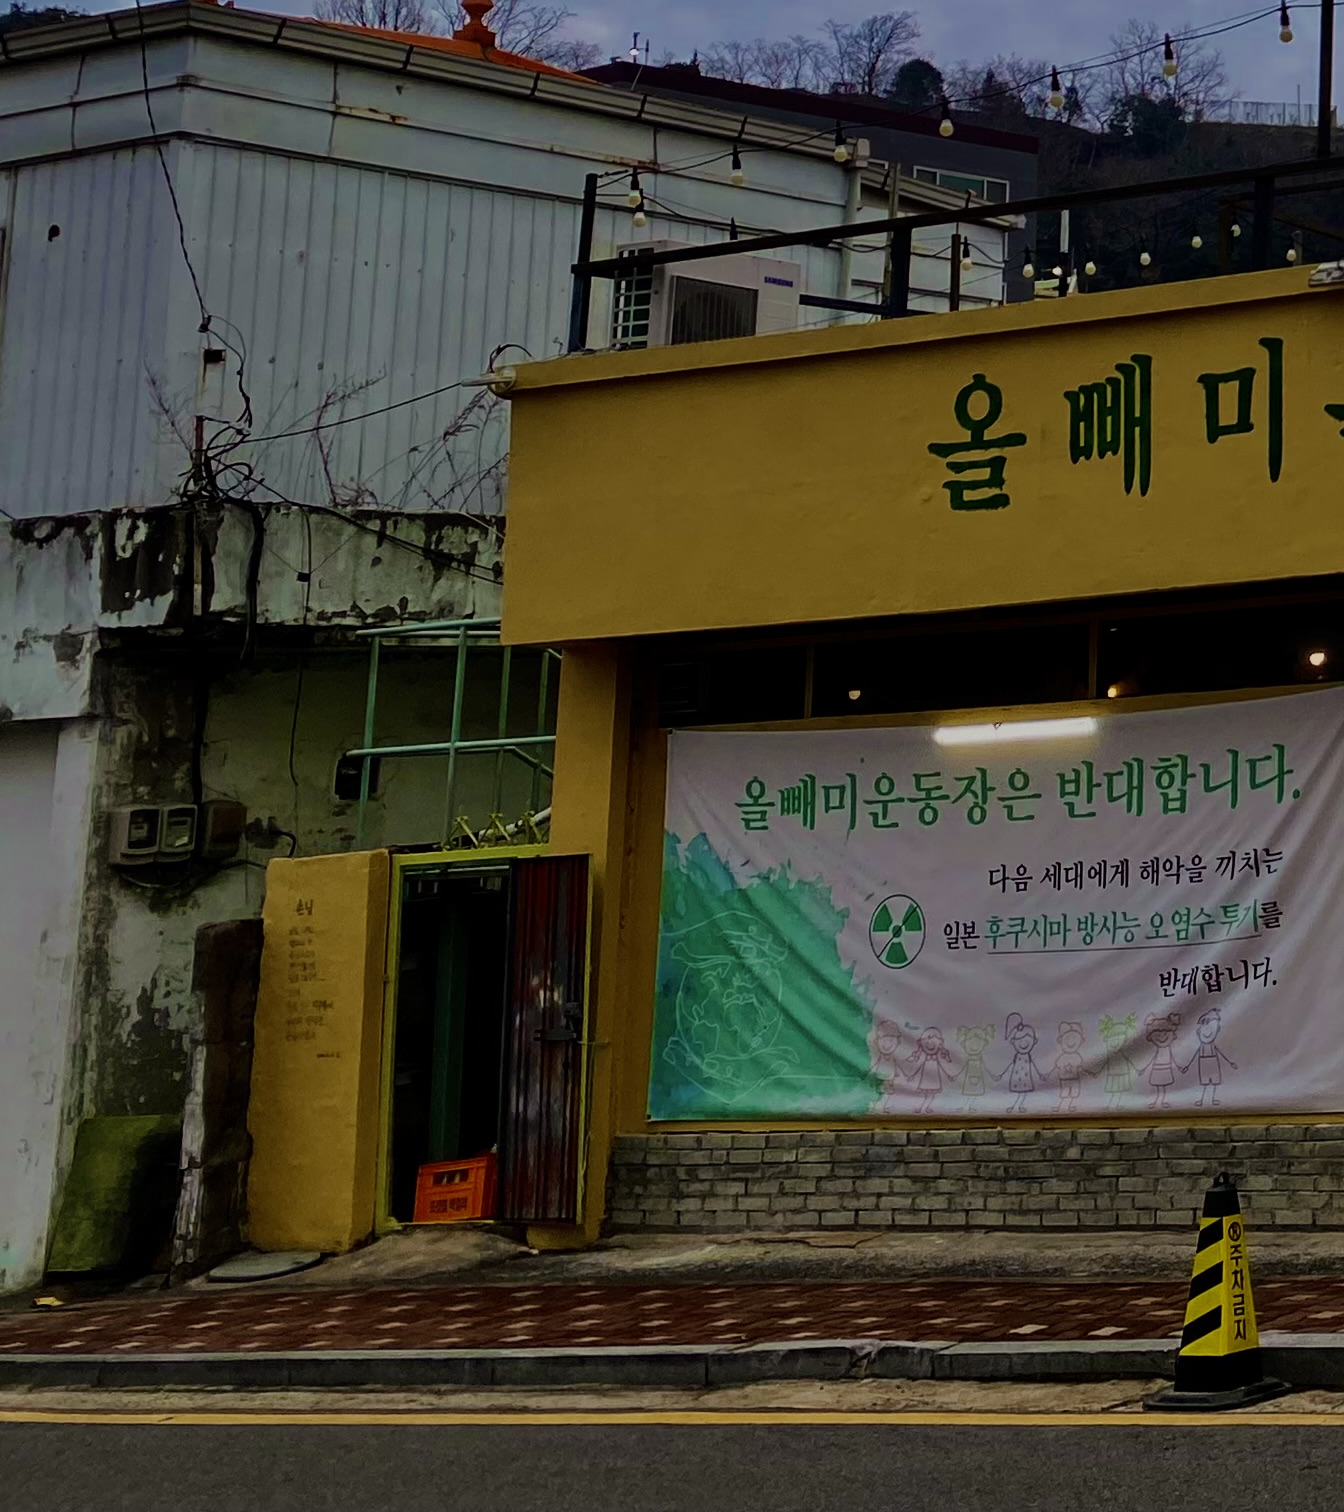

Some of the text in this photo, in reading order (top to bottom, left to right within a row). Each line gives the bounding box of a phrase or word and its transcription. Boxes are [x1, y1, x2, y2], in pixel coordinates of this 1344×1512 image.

[734, 767, 1042, 832] 올빼미운동장은
[1056, 743, 1302, 819] 반대합니다.
[989, 847, 1284, 893] 다음 세대에게 해악을 끼치는
[943, 898, 1284, 950] 일본 후쿠시마 방사능 오염수 투기를
[1159, 956, 1279, 997] 반대합니다.
[1230, 1243, 1247, 1341] 주차금지
